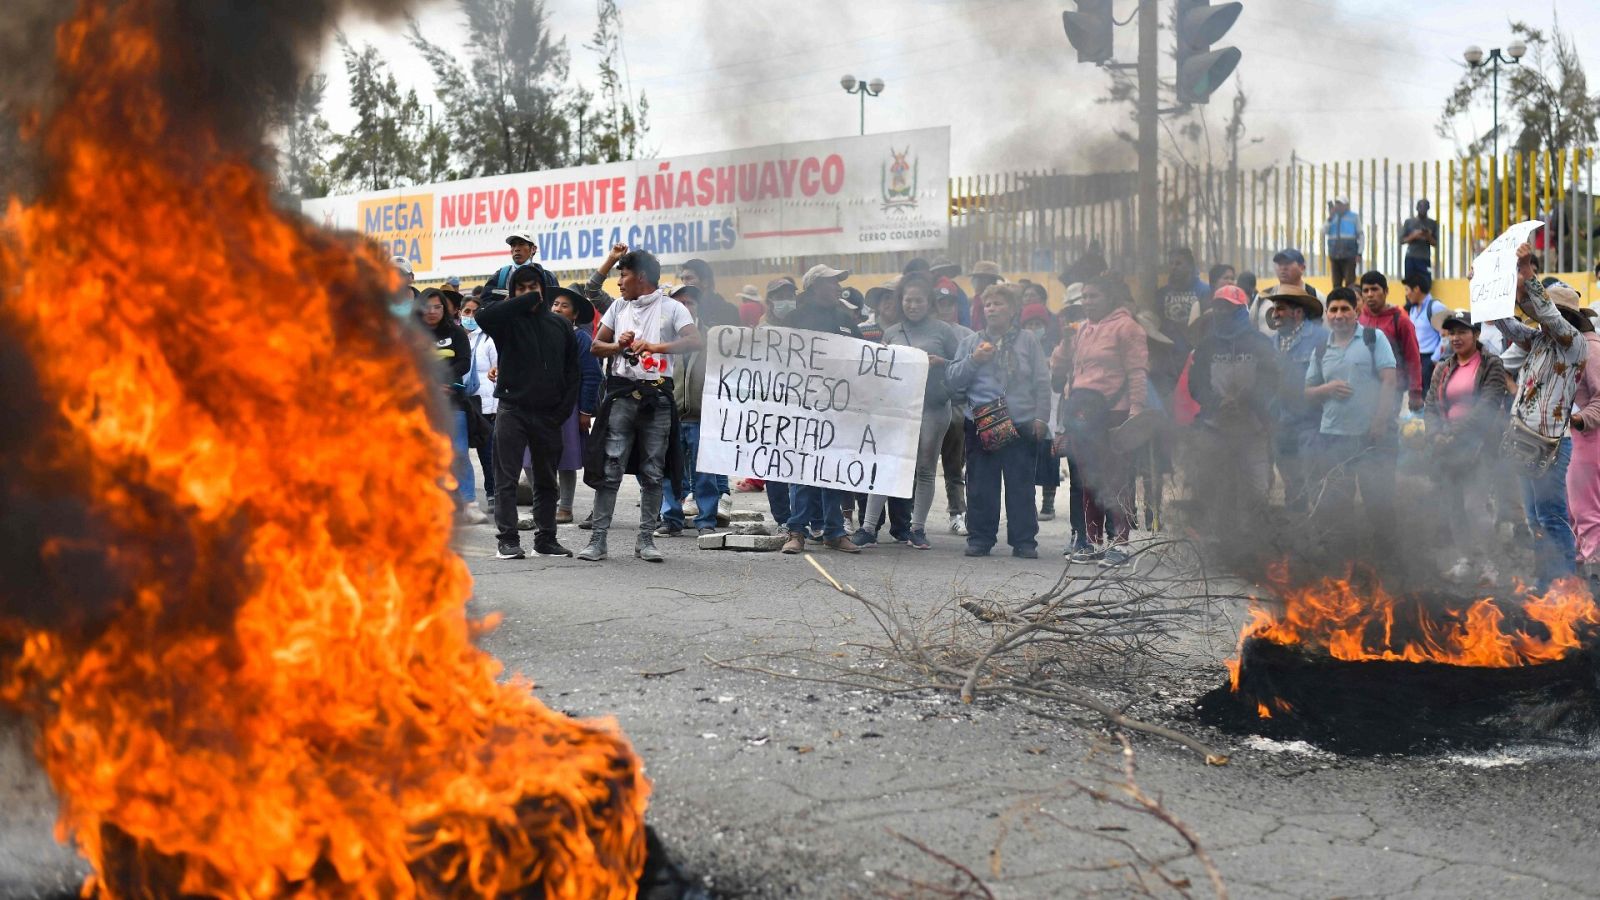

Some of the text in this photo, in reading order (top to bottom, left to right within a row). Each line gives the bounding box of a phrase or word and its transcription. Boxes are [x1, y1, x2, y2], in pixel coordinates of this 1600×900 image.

[440, 154, 845, 229] NUEVO PUENTE AÑASHUAYCO
[365, 202, 423, 233] MEGA
[538, 222, 572, 261] VÍA
[578, 228, 604, 259] DE
[628, 217, 737, 255] CARRILES
[859, 229, 941, 243] CERRO COLORADO
[718, 327, 903, 381] CIERRE DEL
[717, 364, 851, 412] KONGRESO
[859, 423, 877, 455] A
